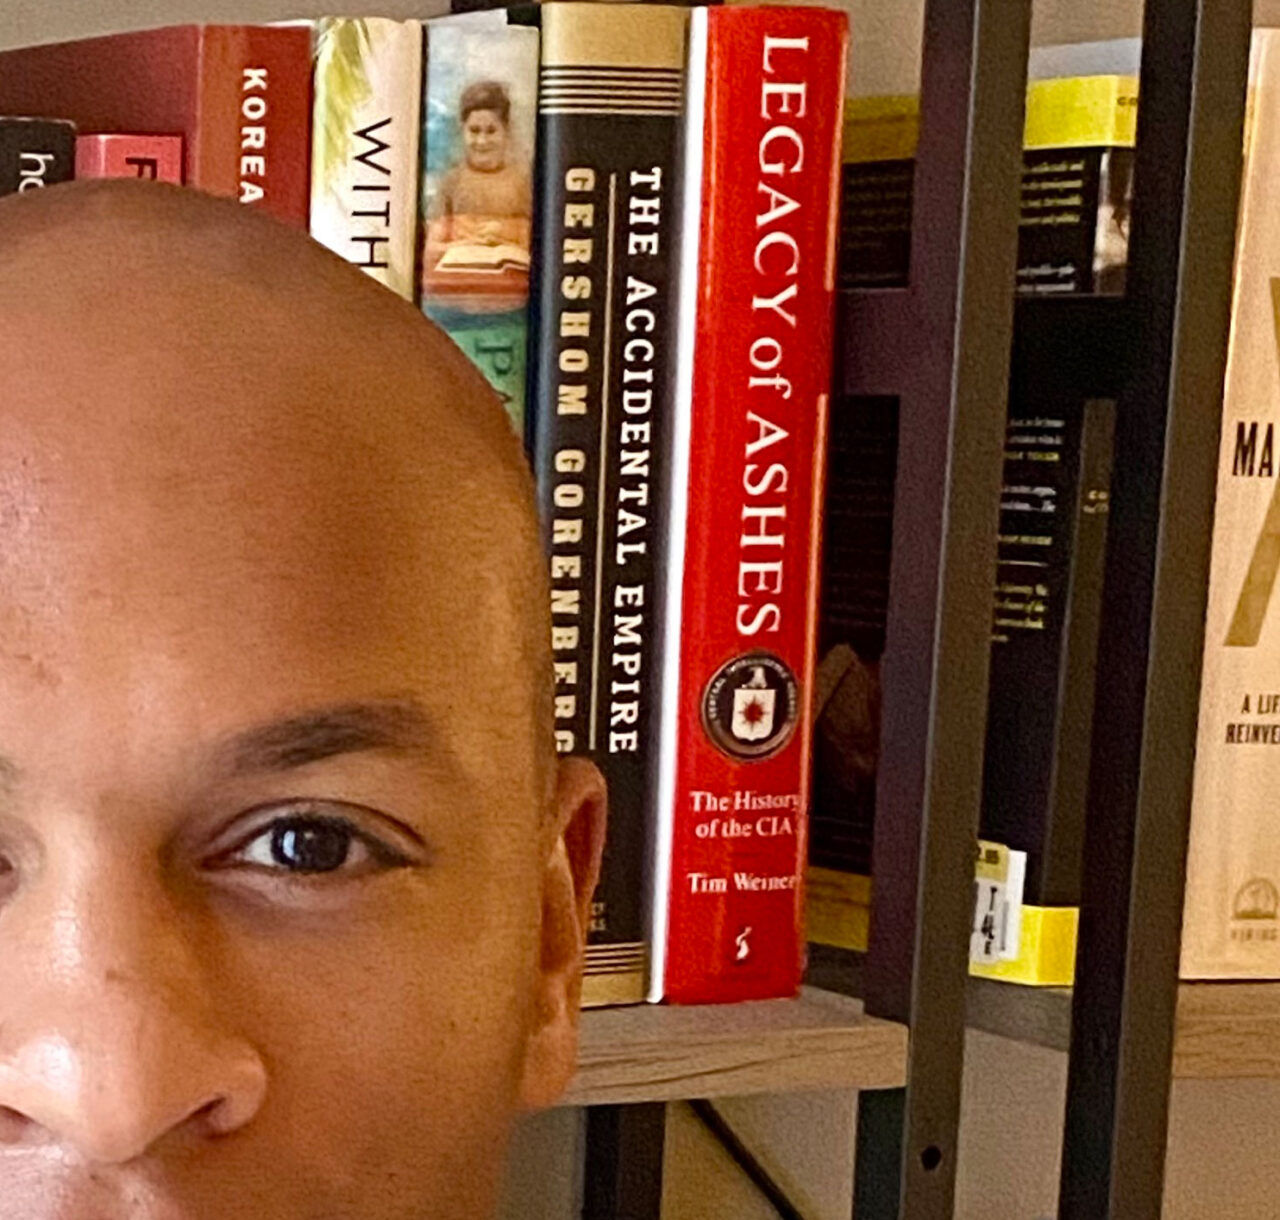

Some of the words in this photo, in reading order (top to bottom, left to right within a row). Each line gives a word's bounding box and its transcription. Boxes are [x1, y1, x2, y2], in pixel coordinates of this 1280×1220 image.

[238, 67, 269, 204] KOREA
[350, 117, 393, 269] WITH
[751, 34, 810, 328] LEGACY
[628, 166, 662, 257] THE
[556, 167, 596, 417] GERSHOM
[615, 276, 658, 566] ACCIDENTAL
[748, 336, 794, 400] of
[736, 410, 790, 637] ASHES
[608, 585, 646, 754] EMPIRE
[1240, 694, 1251, 715] A
[689, 790, 730, 812] The
[733, 790, 801, 814] History
[695, 818, 719, 839] of
[721, 818, 753, 838] the
[755, 816, 793, 837] CIA
[687, 872, 728, 894] Tim
